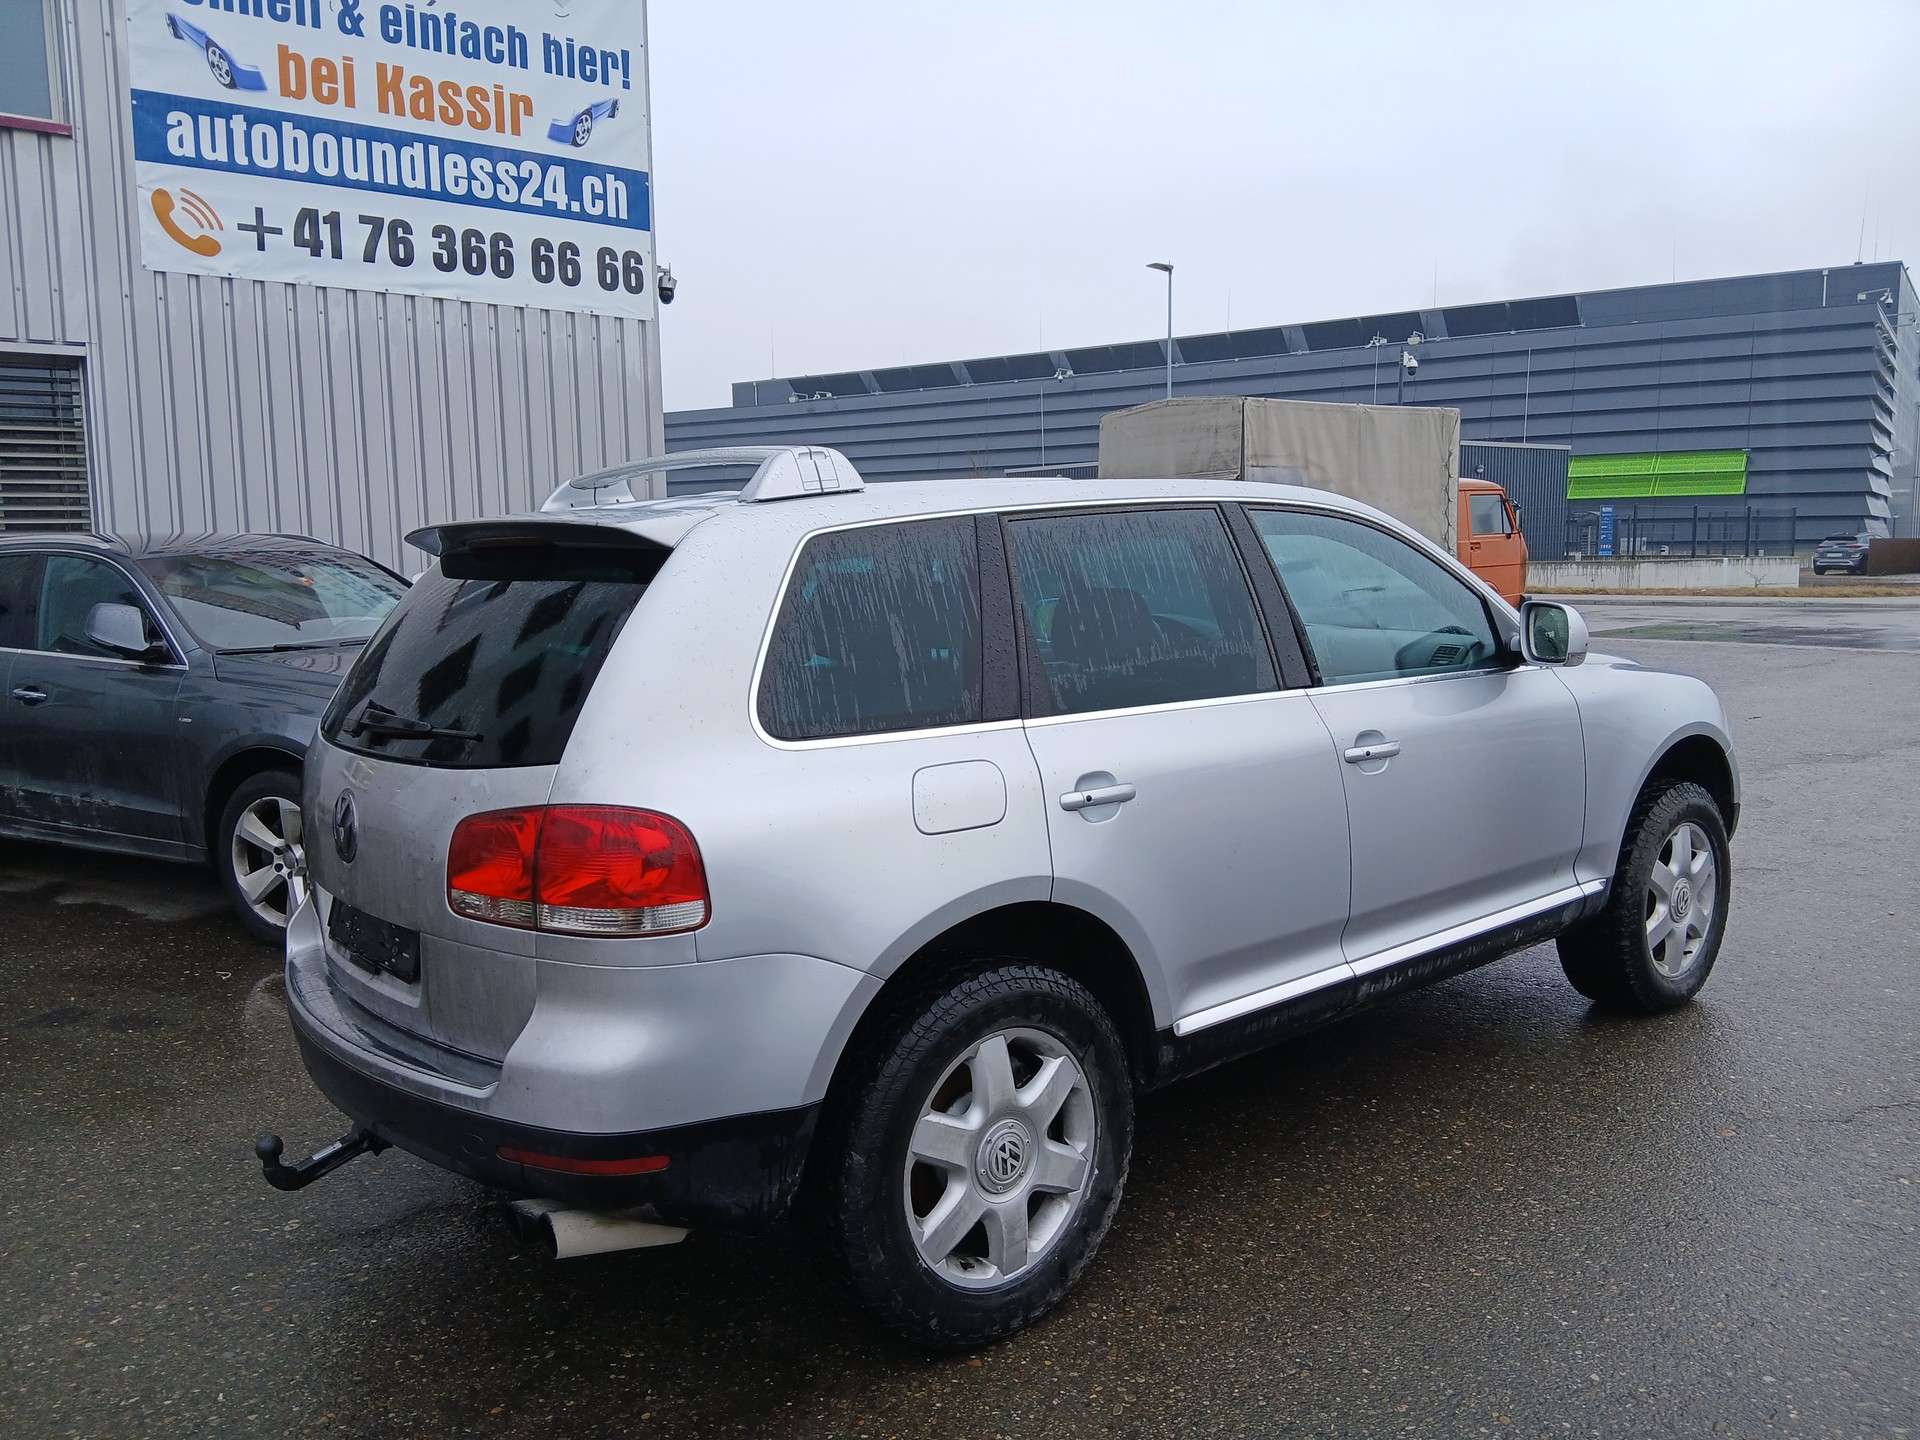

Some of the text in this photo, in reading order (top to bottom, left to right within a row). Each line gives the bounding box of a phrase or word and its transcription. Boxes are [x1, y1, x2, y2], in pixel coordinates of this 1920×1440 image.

[277, 44, 533, 136] bei Kassir
[338, 0, 364, 37] &
[380, 4, 528, 69] einfach
[543, 32, 630, 90] hier!
[166, 111, 627, 219] autoboundless24.ch
[293, 207, 343, 260] 41
[358, 214, 414, 268] 76
[432, 224, 514, 279] 366
[531, 237, 581, 287] 66
[597, 246, 644, 294] 66
